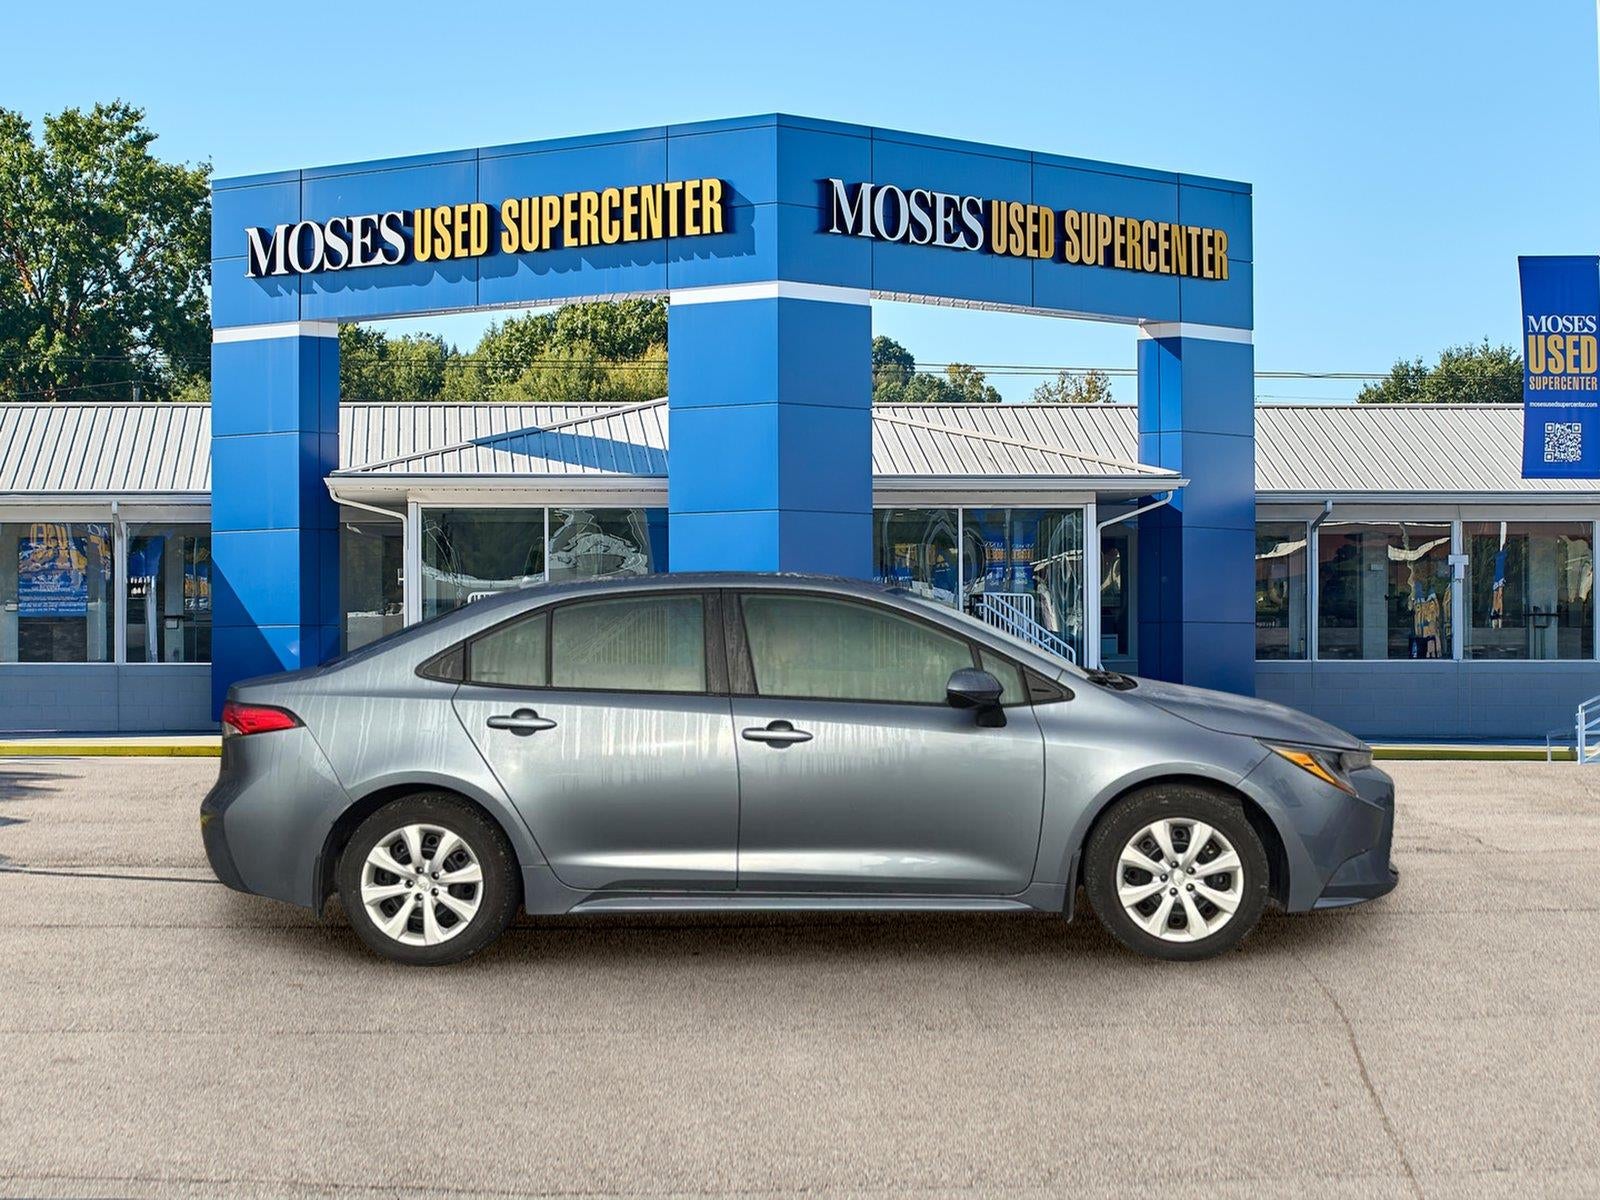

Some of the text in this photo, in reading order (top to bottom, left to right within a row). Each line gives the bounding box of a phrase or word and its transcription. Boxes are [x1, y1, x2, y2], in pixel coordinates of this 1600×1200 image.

[244, 178, 724, 278] MOSES USED SUPERCENTER
[829, 177, 1230, 281] MOSES USED SUPERCENTER
[1527, 315, 1597, 334] MOSES
[1528, 334, 1598, 374] USED
[1529, 376, 1598, 391] SUPERCENTER
[1529, 401, 1598, 409] mosesusedsupercenter.com
